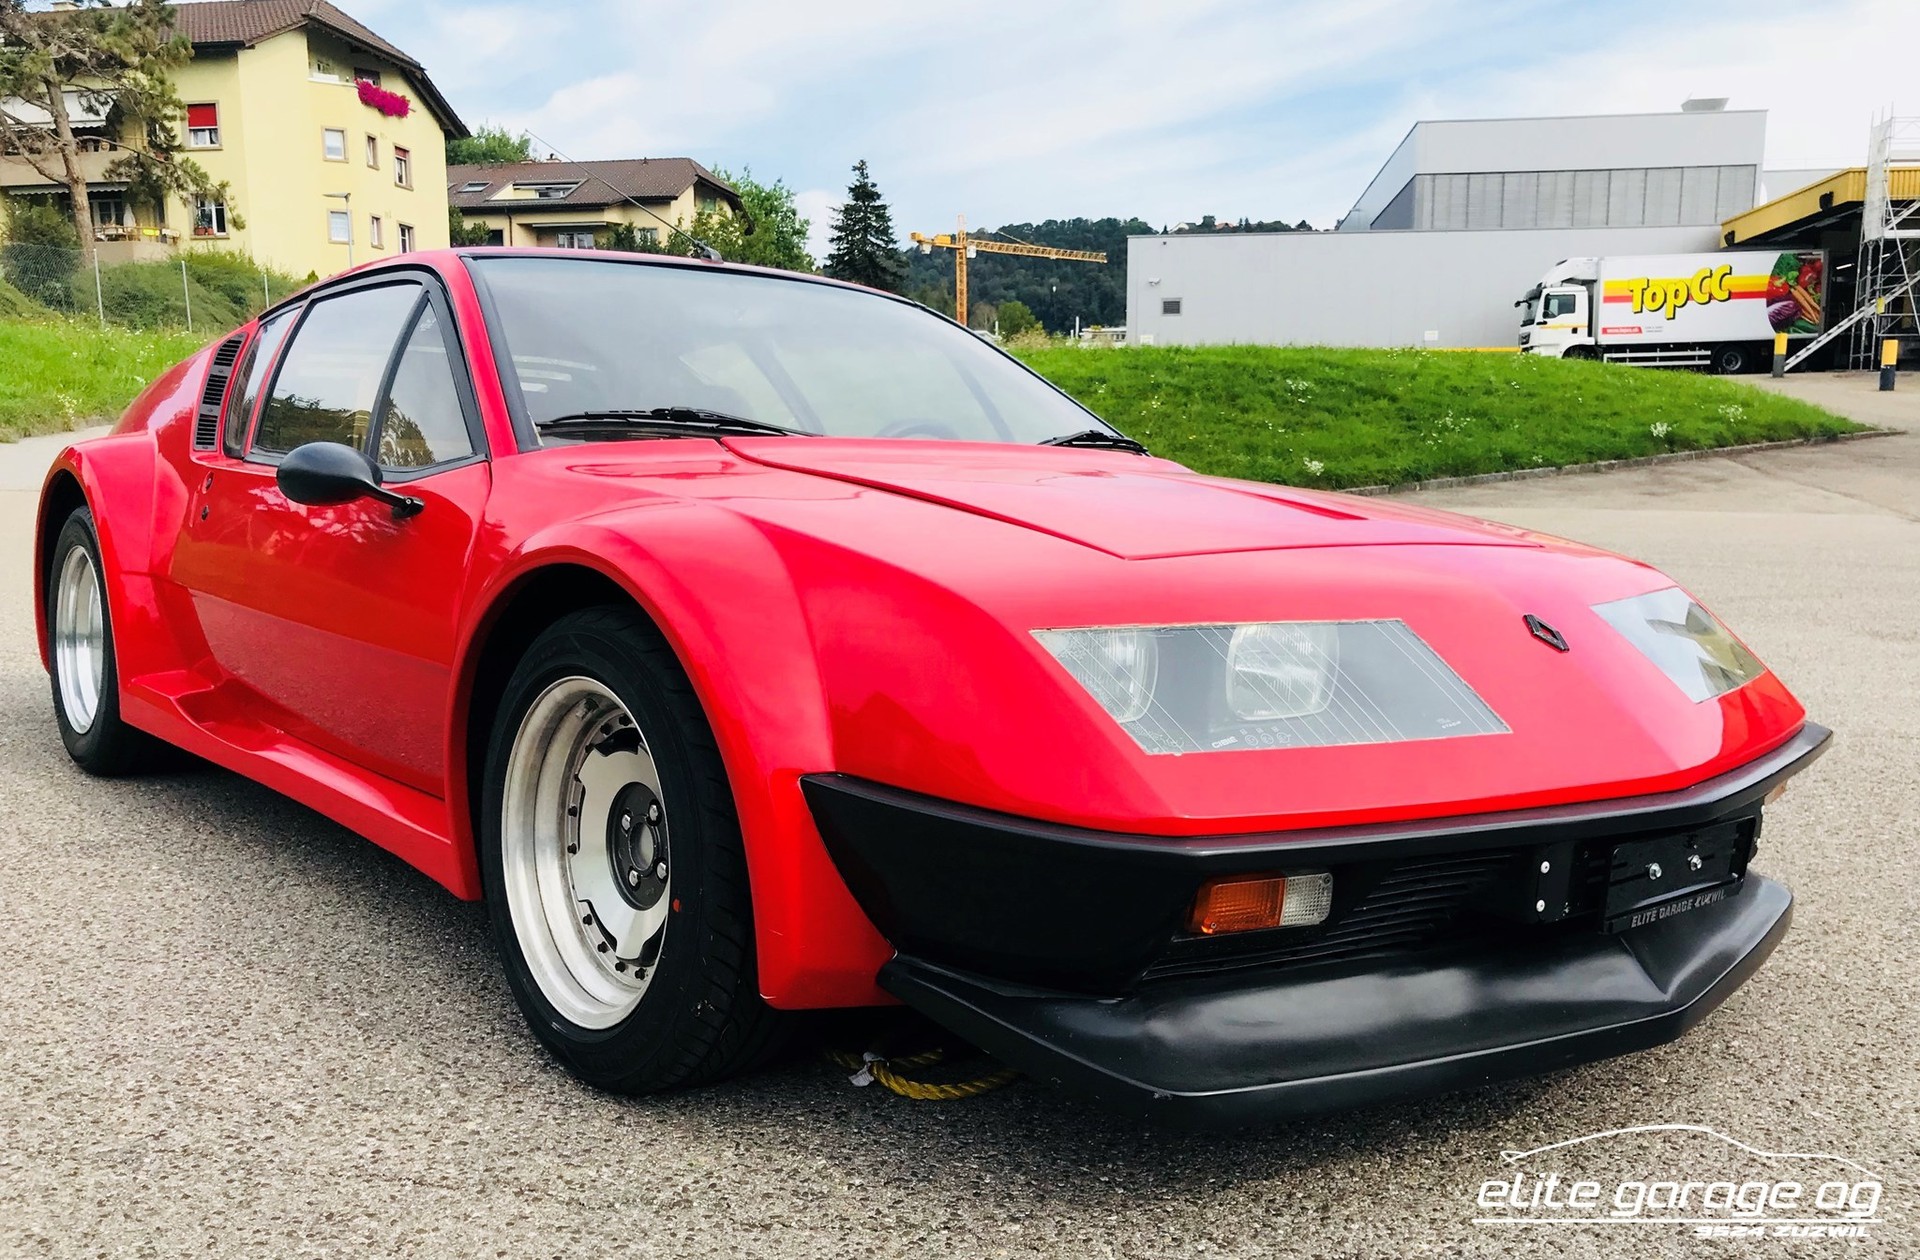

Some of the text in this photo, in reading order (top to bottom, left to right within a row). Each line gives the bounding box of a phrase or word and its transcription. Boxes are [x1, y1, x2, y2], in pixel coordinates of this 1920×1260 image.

[1628, 264, 1732, 319] TopCC
[1631, 907, 1657, 928] ELITE
[1658, 899, 1693, 919] GARAGE
